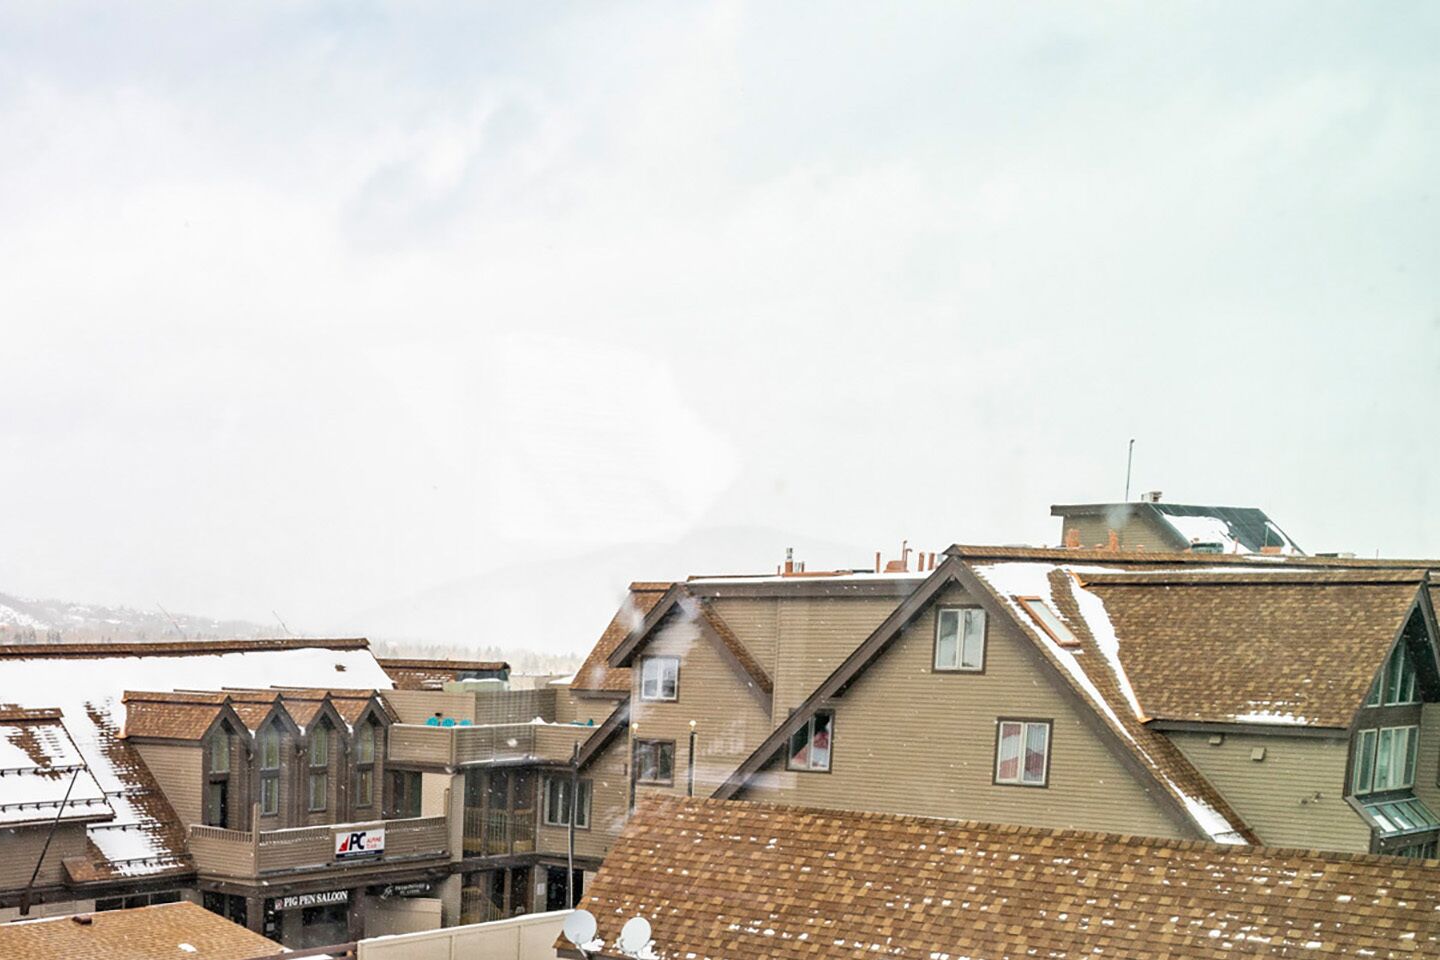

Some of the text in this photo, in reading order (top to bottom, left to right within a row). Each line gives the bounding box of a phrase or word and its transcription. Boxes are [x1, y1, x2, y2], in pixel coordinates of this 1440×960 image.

[349, 832, 366, 850] PC
[283, 890, 348, 907] PIG PEN SALOON
